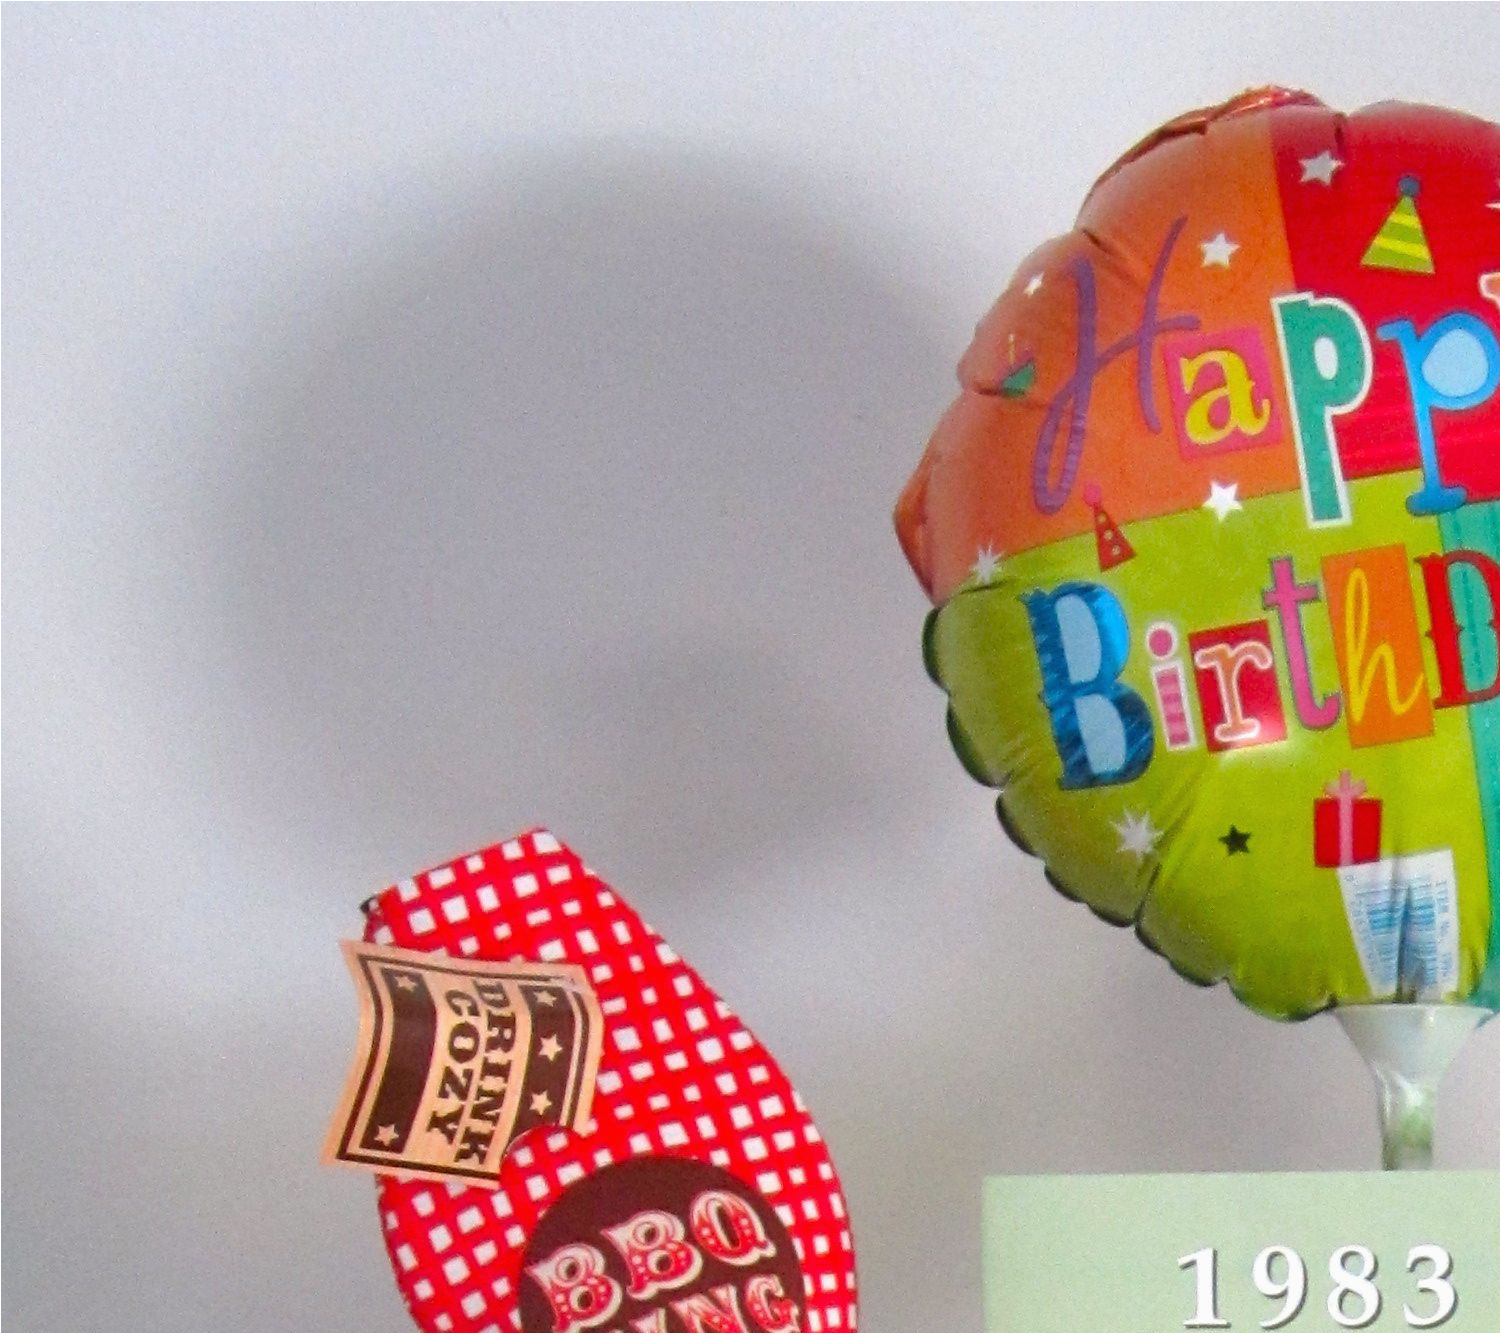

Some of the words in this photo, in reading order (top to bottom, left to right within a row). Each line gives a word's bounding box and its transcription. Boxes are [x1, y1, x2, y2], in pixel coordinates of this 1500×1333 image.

[427, 989, 481, 1146] COZY
[455, 977, 518, 1165] DRINK
[1177, 1243, 1459, 1329] 1983
